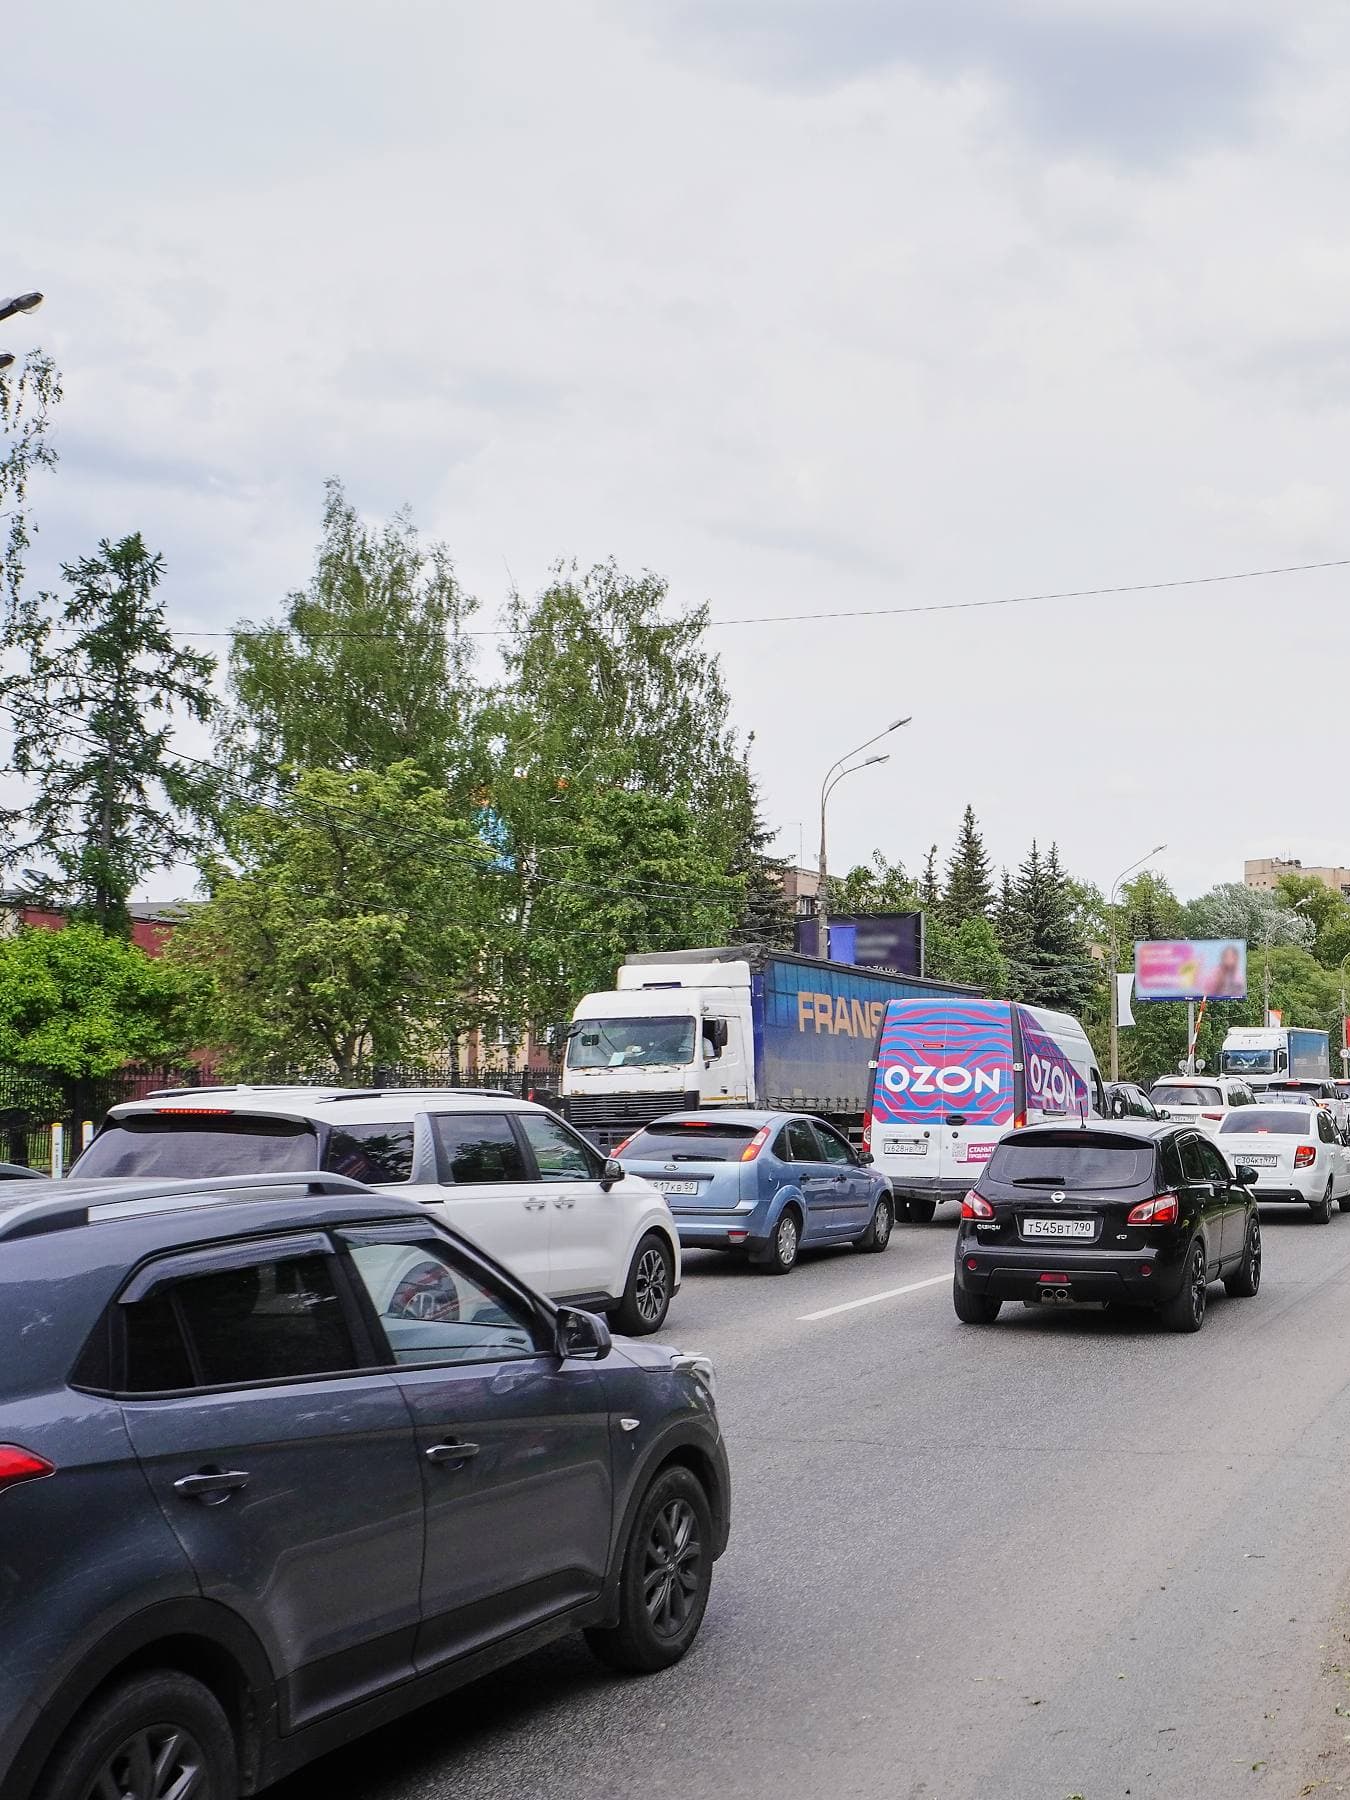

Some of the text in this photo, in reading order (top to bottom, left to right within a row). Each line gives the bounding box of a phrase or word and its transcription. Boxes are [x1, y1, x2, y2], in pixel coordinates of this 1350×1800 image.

[883, 1065, 1001, 1094] OZON
[1030, 1053, 1076, 1110] OZON
[1074, 1223, 1090, 1232] 790
